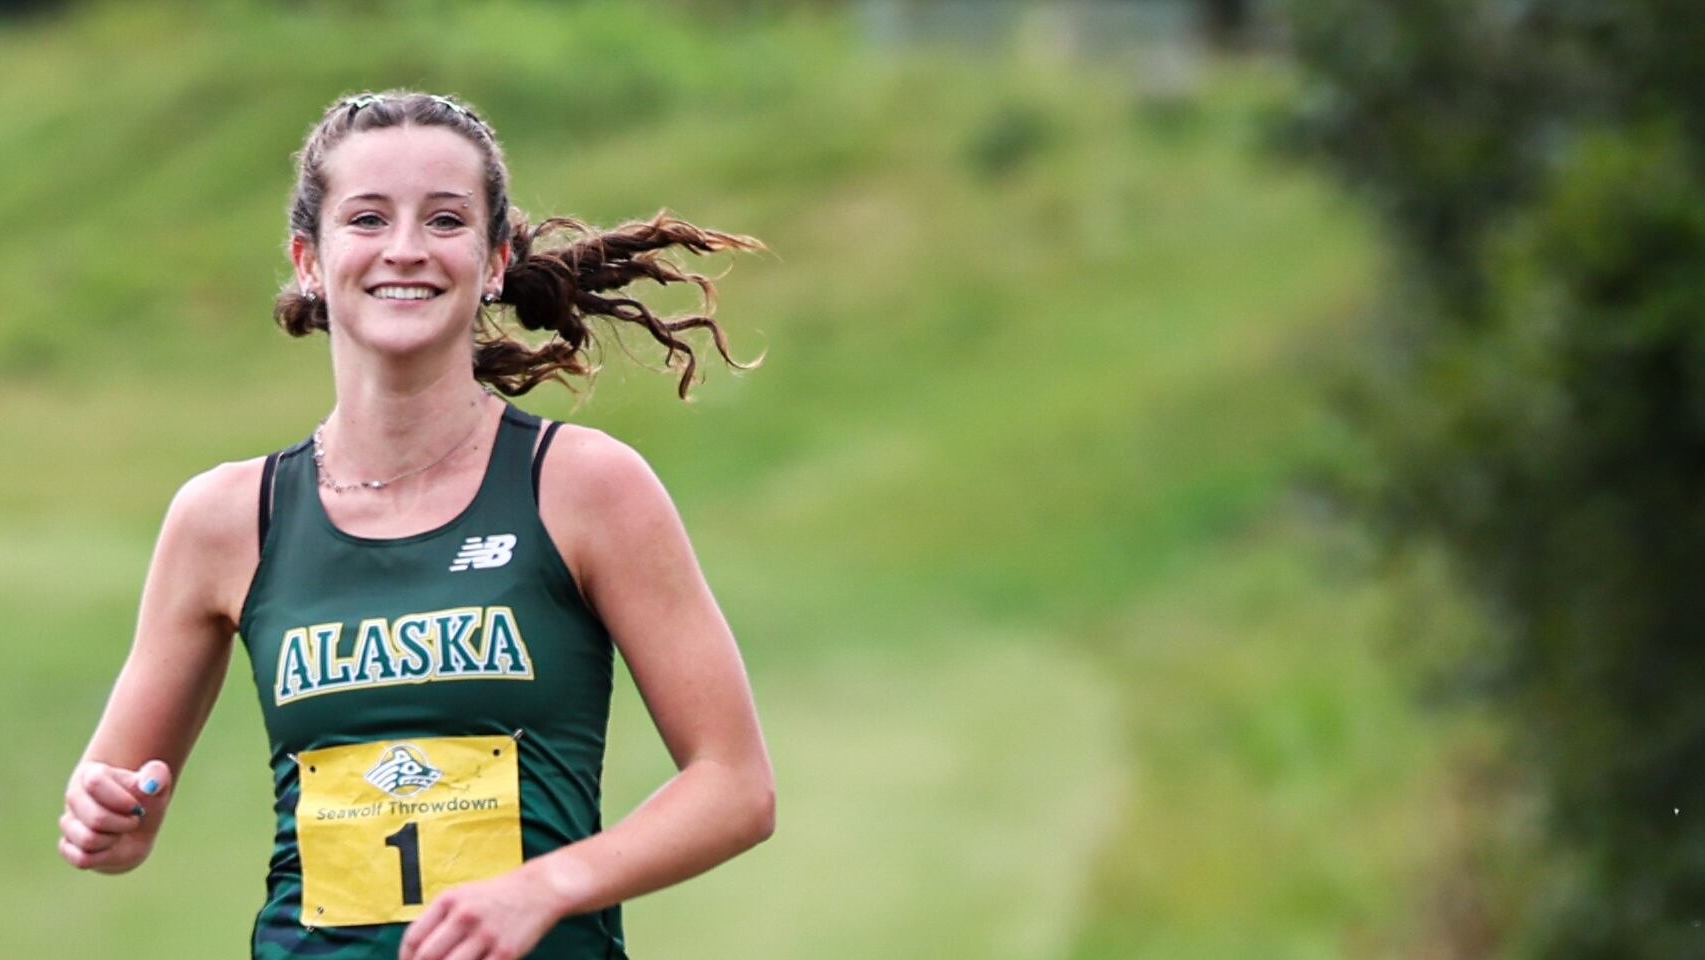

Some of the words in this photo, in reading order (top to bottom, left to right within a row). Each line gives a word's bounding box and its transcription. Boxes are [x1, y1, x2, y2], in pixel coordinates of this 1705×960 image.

[449, 534, 517, 571] NB
[276, 606, 534, 705] ALASKA
[316, 802, 383, 821] Seawolf
[389, 797, 499, 816] Throwdown
[385, 822, 423, 906] 1
